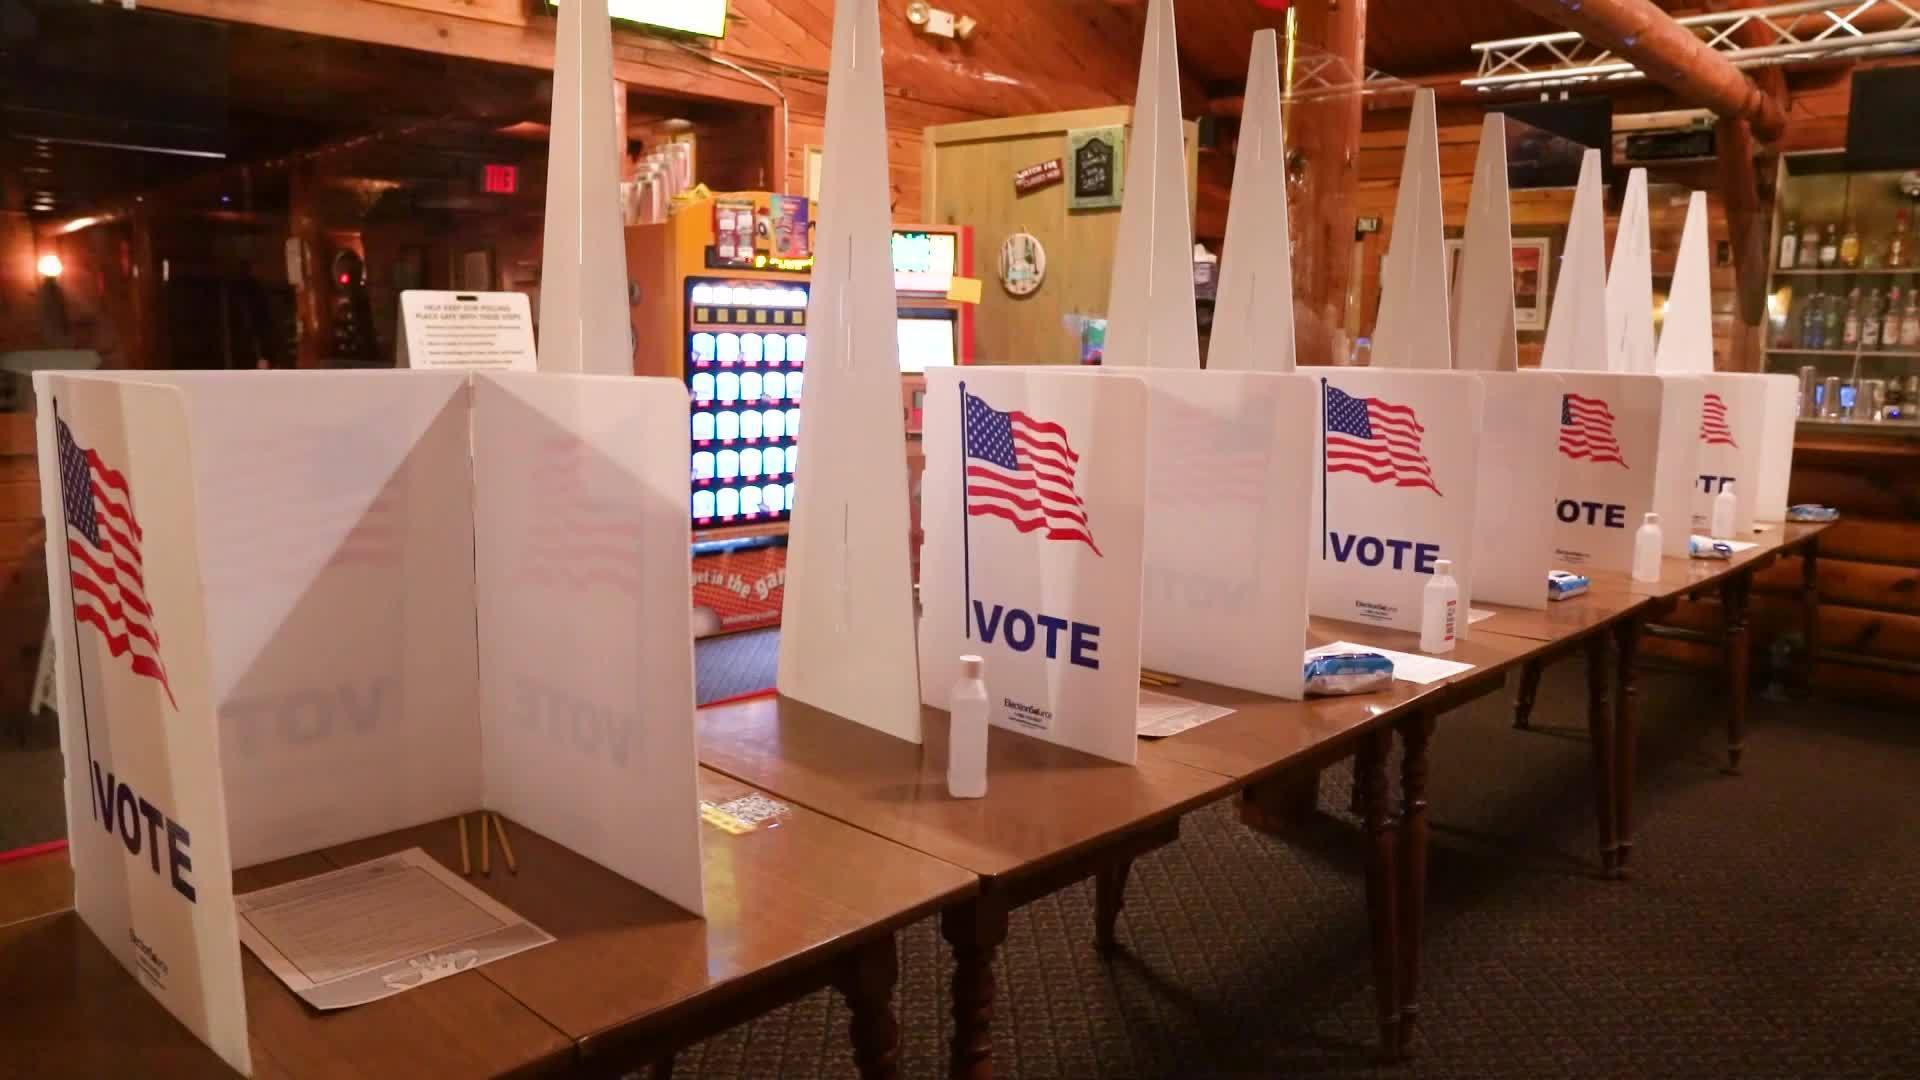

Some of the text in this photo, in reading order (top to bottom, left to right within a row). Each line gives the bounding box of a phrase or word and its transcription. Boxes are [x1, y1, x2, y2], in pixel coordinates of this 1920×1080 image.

[1694, 475, 1736, 494] TE
[1555, 498, 1626, 528] OTE
[1329, 531, 1440, 575] VOTE
[710, 571, 724, 585] in
[728, 573, 751, 600] the
[973, 599, 1100, 670] VOTE
[93, 760, 197, 904] VOTE
